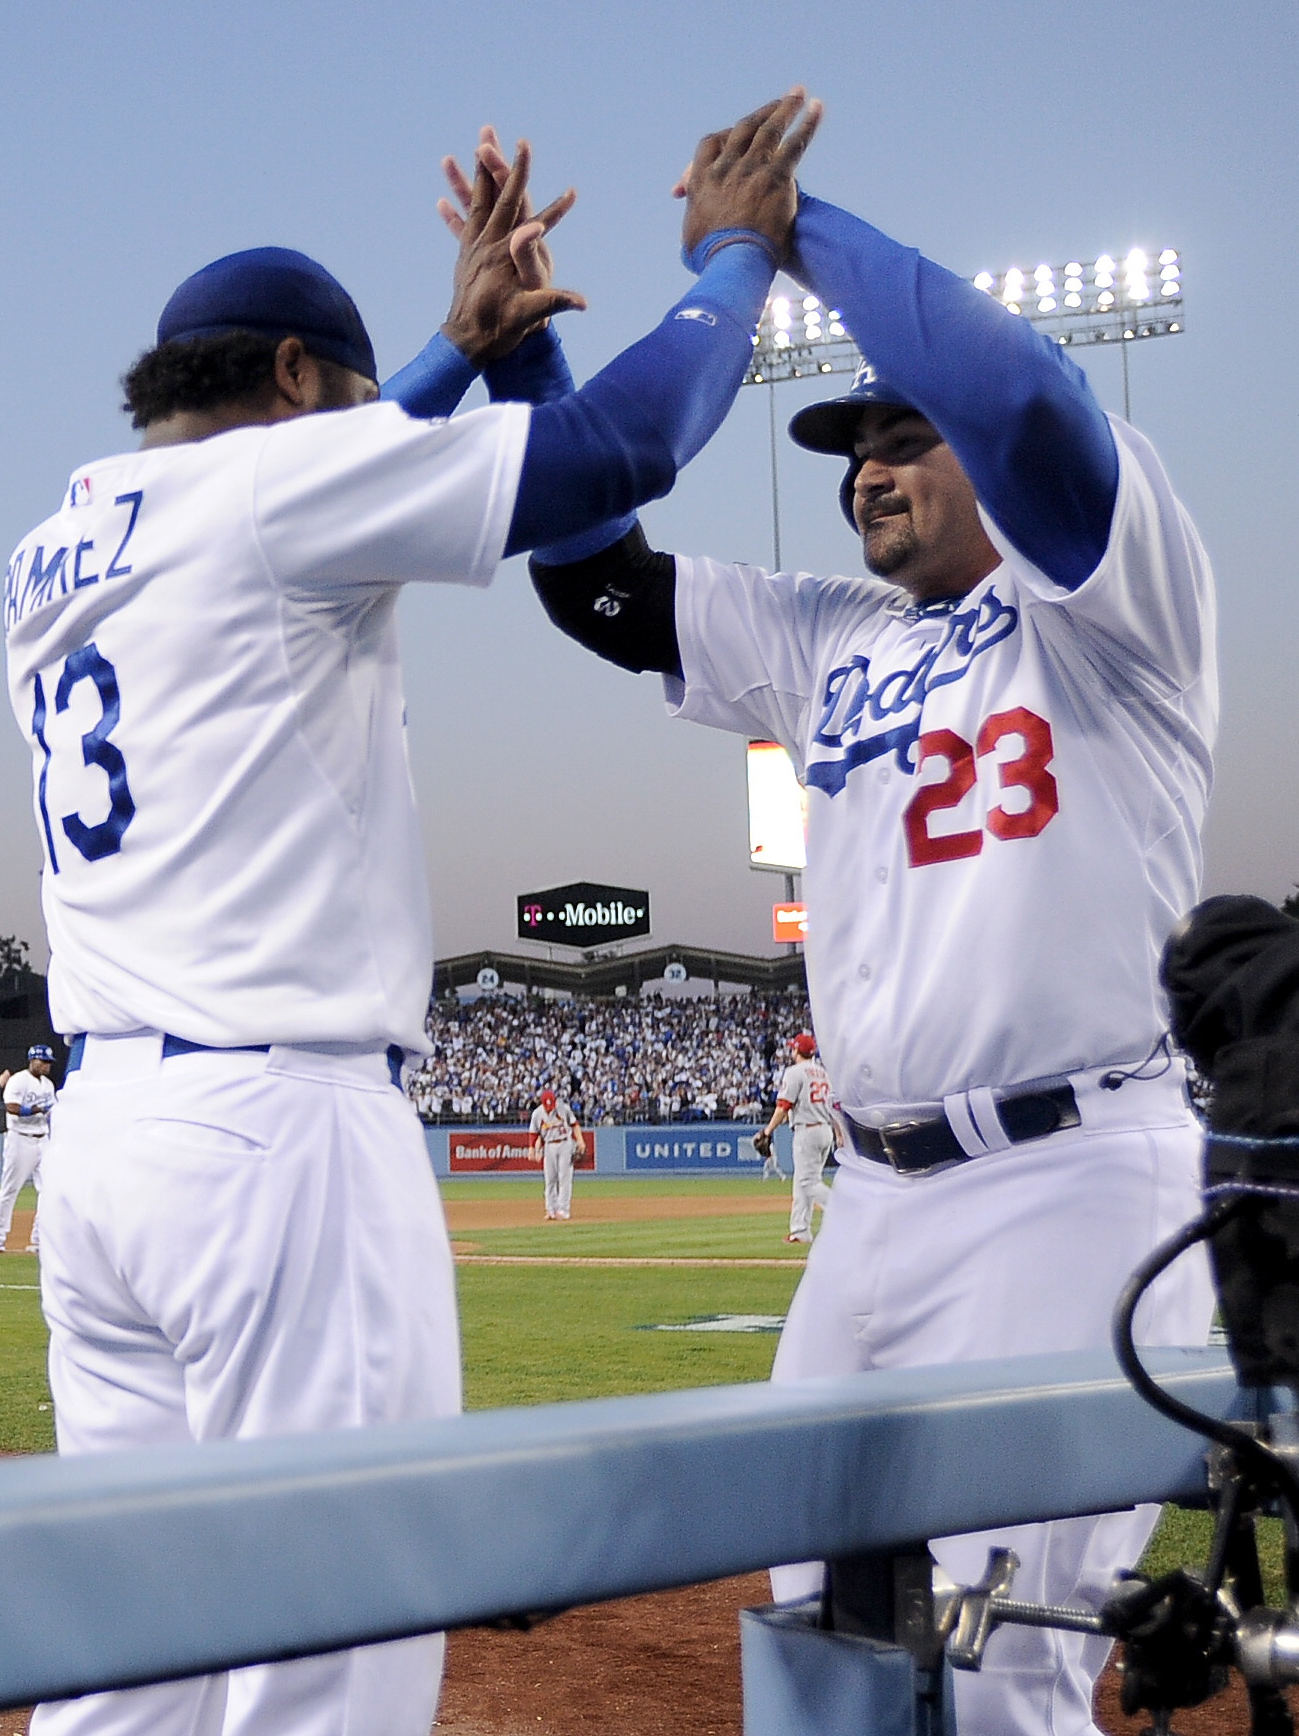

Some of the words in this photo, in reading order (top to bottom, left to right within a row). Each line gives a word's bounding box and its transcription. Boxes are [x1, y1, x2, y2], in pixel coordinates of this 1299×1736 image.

[31, 642, 136, 875] 13
[901, 706, 1059, 868] 23
[455, 1144, 488, 1159] Bank
[488, 1144, 502, 1158] of
[635, 1142, 732, 1158] UNITED
